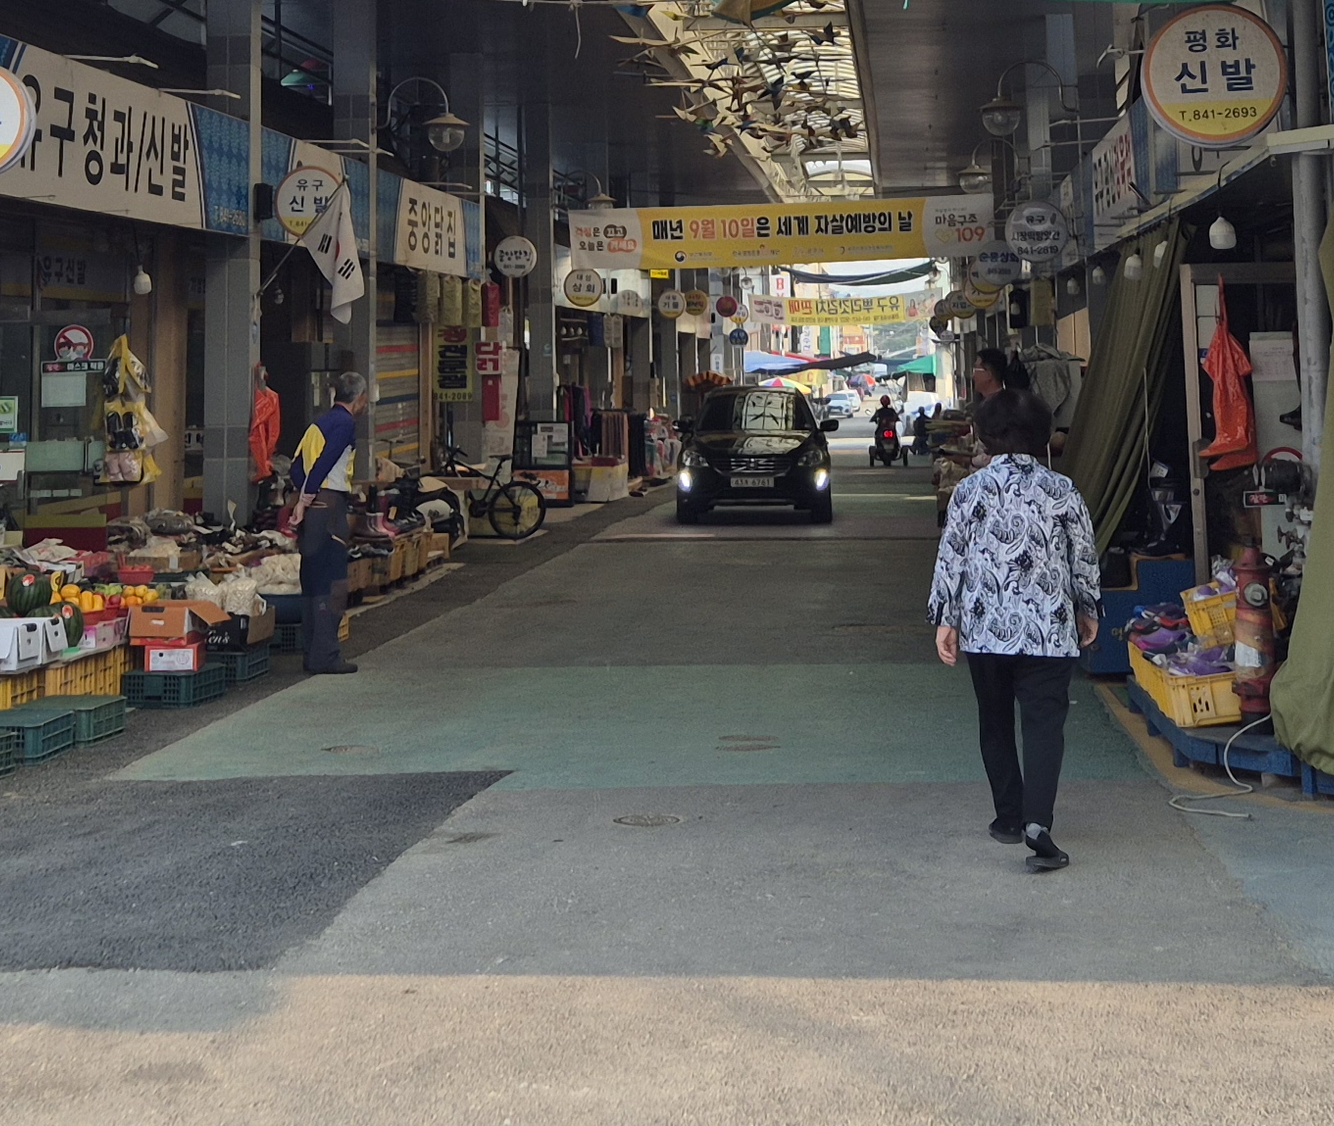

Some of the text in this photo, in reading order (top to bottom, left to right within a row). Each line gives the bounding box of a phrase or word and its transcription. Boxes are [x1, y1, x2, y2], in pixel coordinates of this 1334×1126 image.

[1184, 26, 1239, 54] 평화
[1173, 55, 1257, 96] 신발
[1179, 106, 1258, 122] T.841-2693
[296, 178, 324, 192] 유구
[406, 196, 457, 260] 중앙닭집
[651, 209, 913, 240] 매년 9월 10일은 세계 자살예방의 날
[935, 213, 977, 227] 마음구조
[955, 226, 986, 242] 109
[475, 342, 502, 372] 닭
